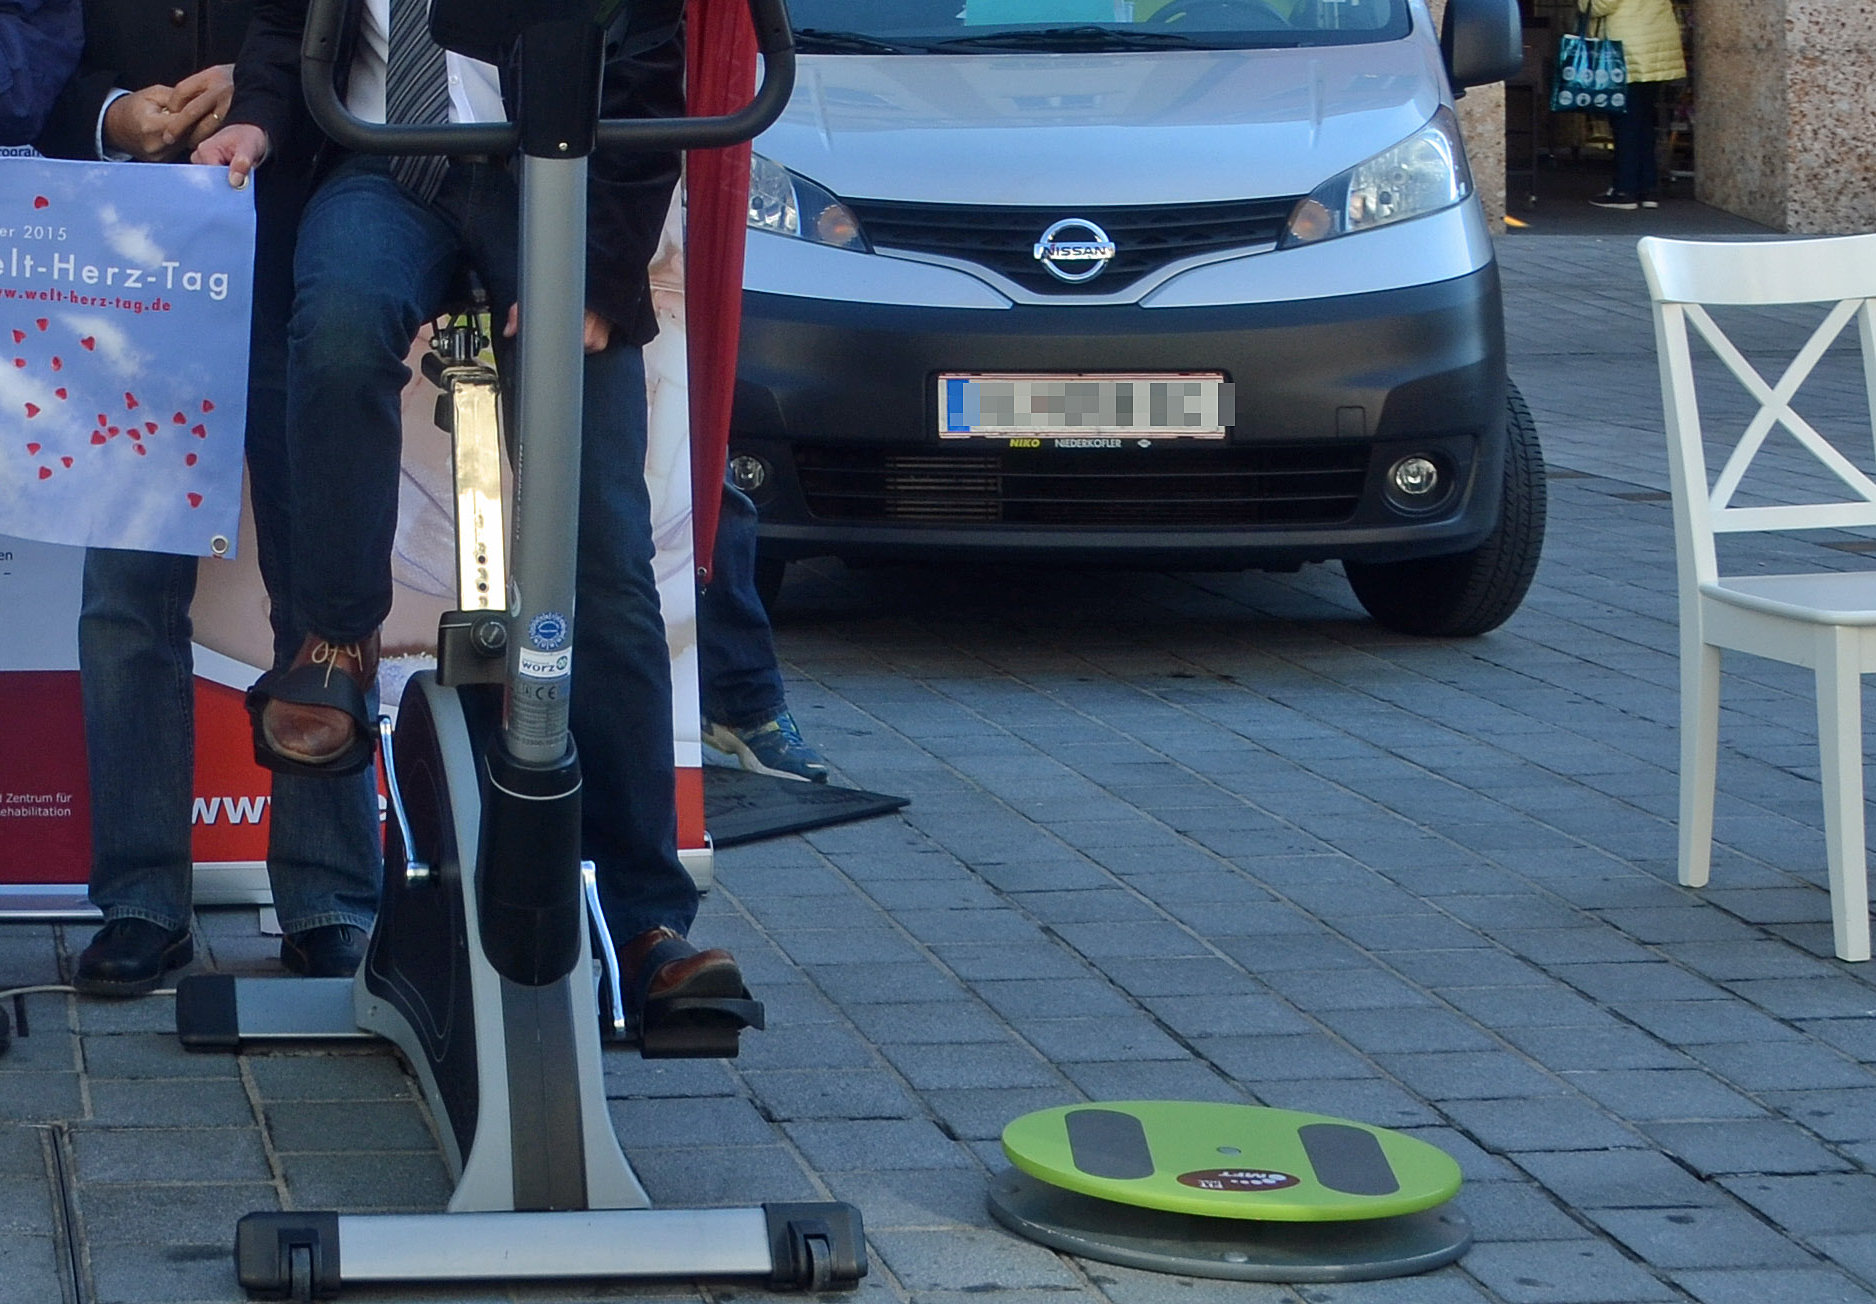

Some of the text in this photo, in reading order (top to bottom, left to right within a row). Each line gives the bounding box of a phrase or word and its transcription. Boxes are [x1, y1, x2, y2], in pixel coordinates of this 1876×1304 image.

[23, 224, 68, 241] 2015
[1042, 245, 1107, 257] NISSAN
[1009, 438, 1122, 449] NIKO NIEDERKOFLER
[6, 793, 53, 804] Zentrum
[56, 792, 72, 804] für
